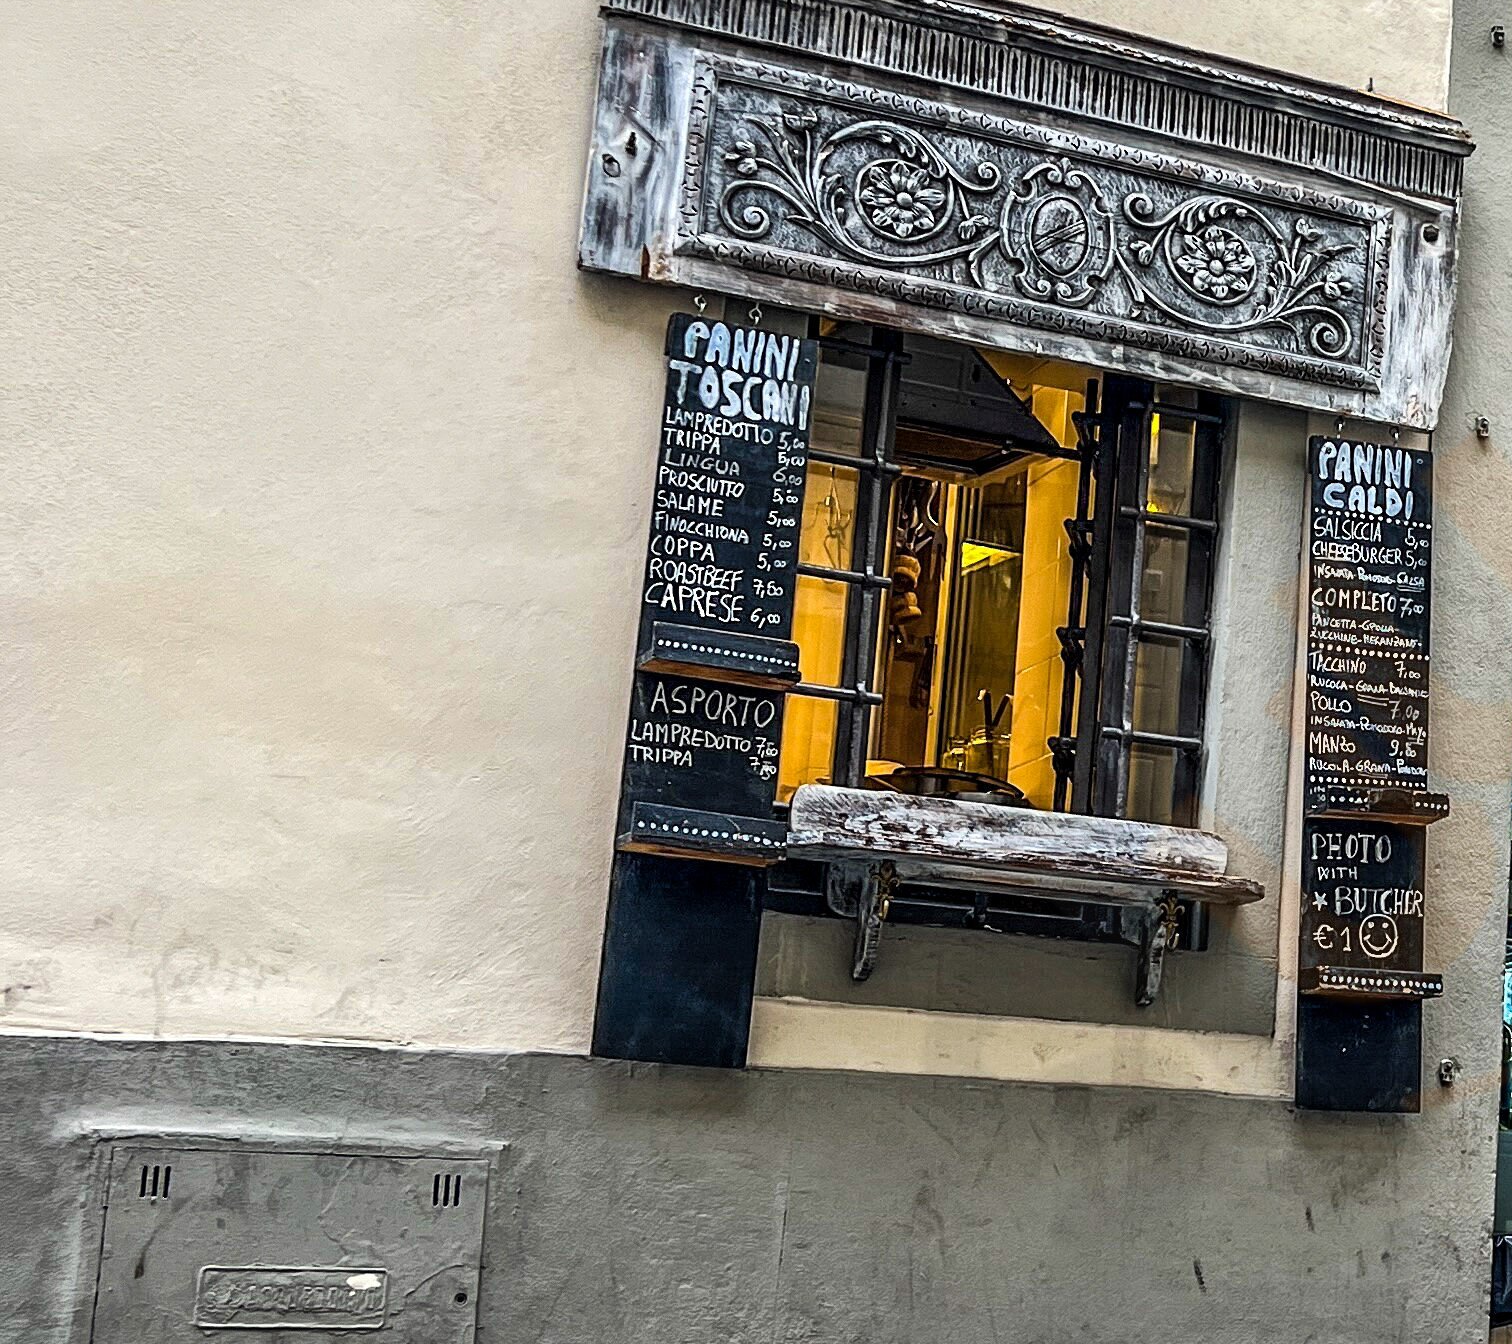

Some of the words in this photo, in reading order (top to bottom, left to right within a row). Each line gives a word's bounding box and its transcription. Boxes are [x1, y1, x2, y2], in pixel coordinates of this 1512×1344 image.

[684, 321, 800, 381] PANINI
[669, 359, 810, 431] TOSCANI
[663, 427, 721, 455] TRIPPA
[665, 406, 774, 445] LAMPREDOTTO
[664, 448, 740, 476] LINGUA
[1318, 441, 1412, 489] PANINI
[658, 466, 746, 498] PROSCIUTTO
[656, 490, 724, 517] SALAME
[1323, 482, 1414, 521] CALDI
[654, 510, 750, 544] FINOCCHIONA
[1313, 516, 1382, 543] SALSICCIA
[650, 534, 715, 562] COPPA
[649, 557, 744, 592] ROASTBEEF
[644, 582, 745, 623] CAPRESE
[1311, 587, 1397, 613] COMPLETO
[1308, 651, 1367, 675] TACCHINO
[650, 681, 775, 728] ASPORTO
[1310, 690, 1352, 713] POLLO
[631, 719, 751, 753] LAMPREDOTTO
[627, 744, 693, 767] TRIPPA
[1311, 833, 1392, 864] PHOTO
[1317, 866, 1358, 881] WITH
[1334, 886, 1423, 917] BUTCHER
